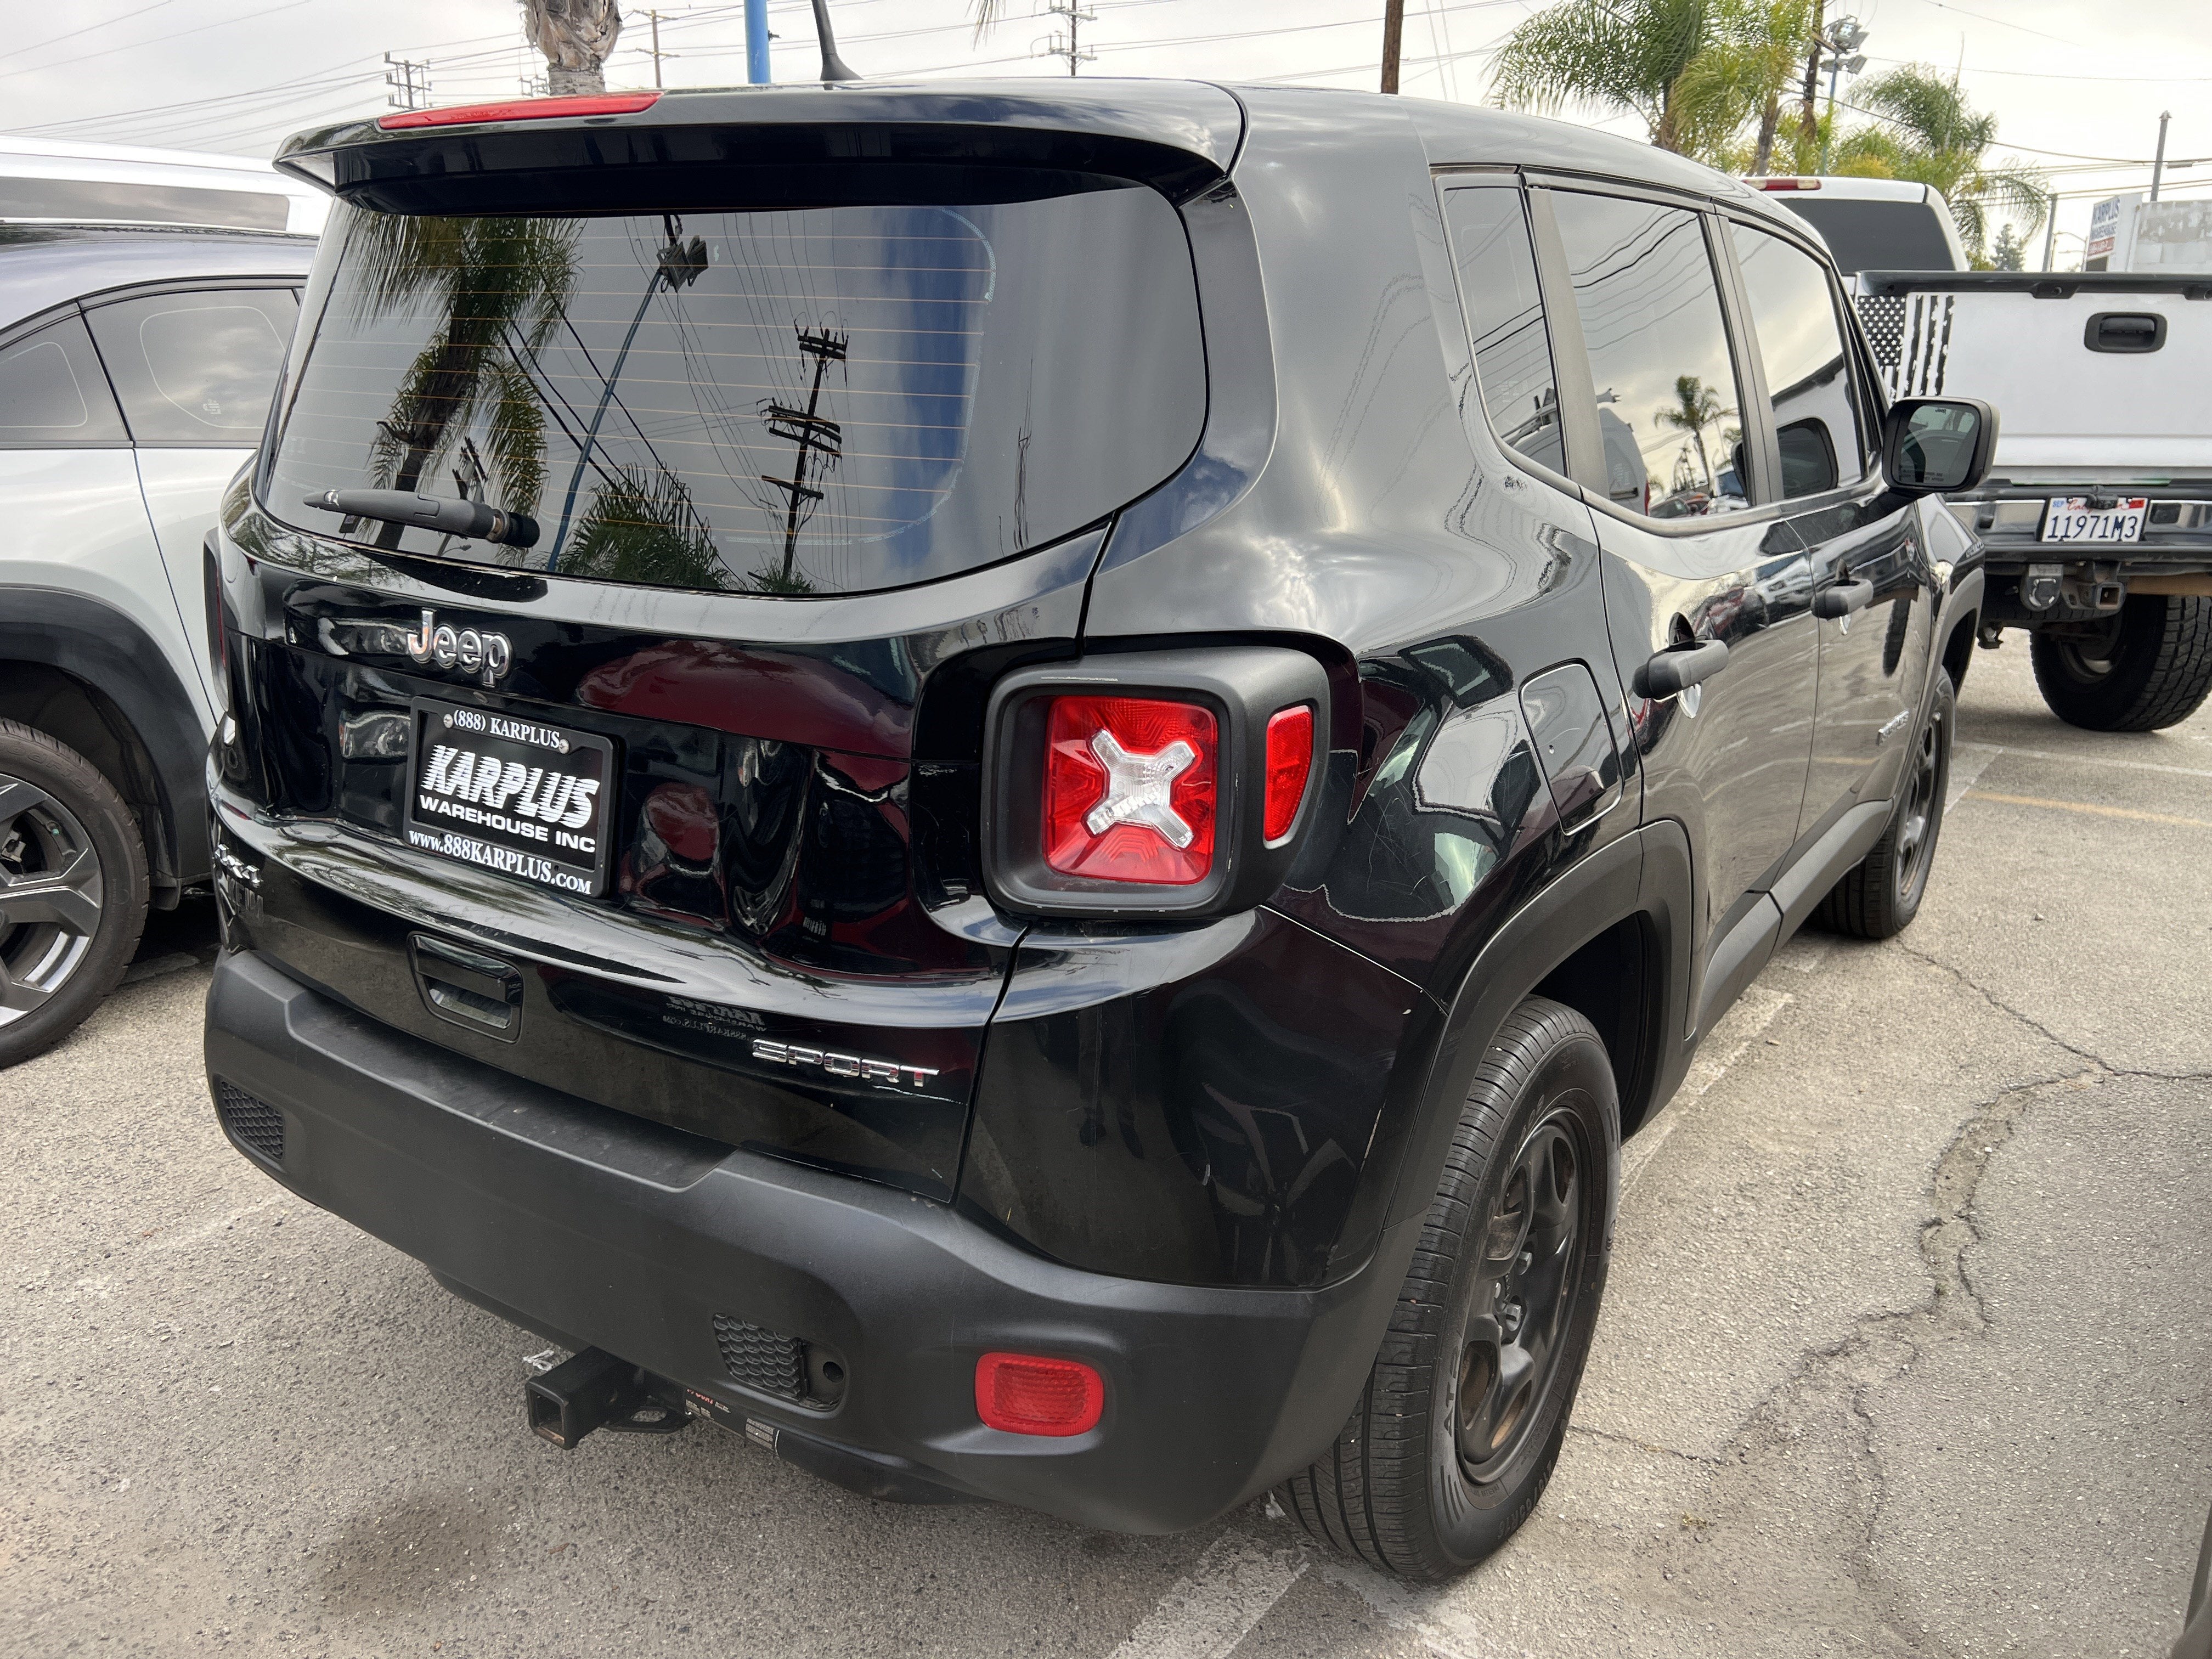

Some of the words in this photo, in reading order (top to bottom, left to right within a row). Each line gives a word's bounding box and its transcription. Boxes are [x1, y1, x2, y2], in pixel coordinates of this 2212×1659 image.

[2047, 516, 2138, 539] 11971M3
[407, 608, 512, 687] Jeep
[453, 709, 487, 732] (888)
[490, 717, 560, 749] KARPLUS
[421, 744, 600, 829] KARPLUS
[420, 794, 549, 842] WAREHOUSE
[555, 830, 596, 853] INC
[752, 1039, 940, 1087] SPORT
